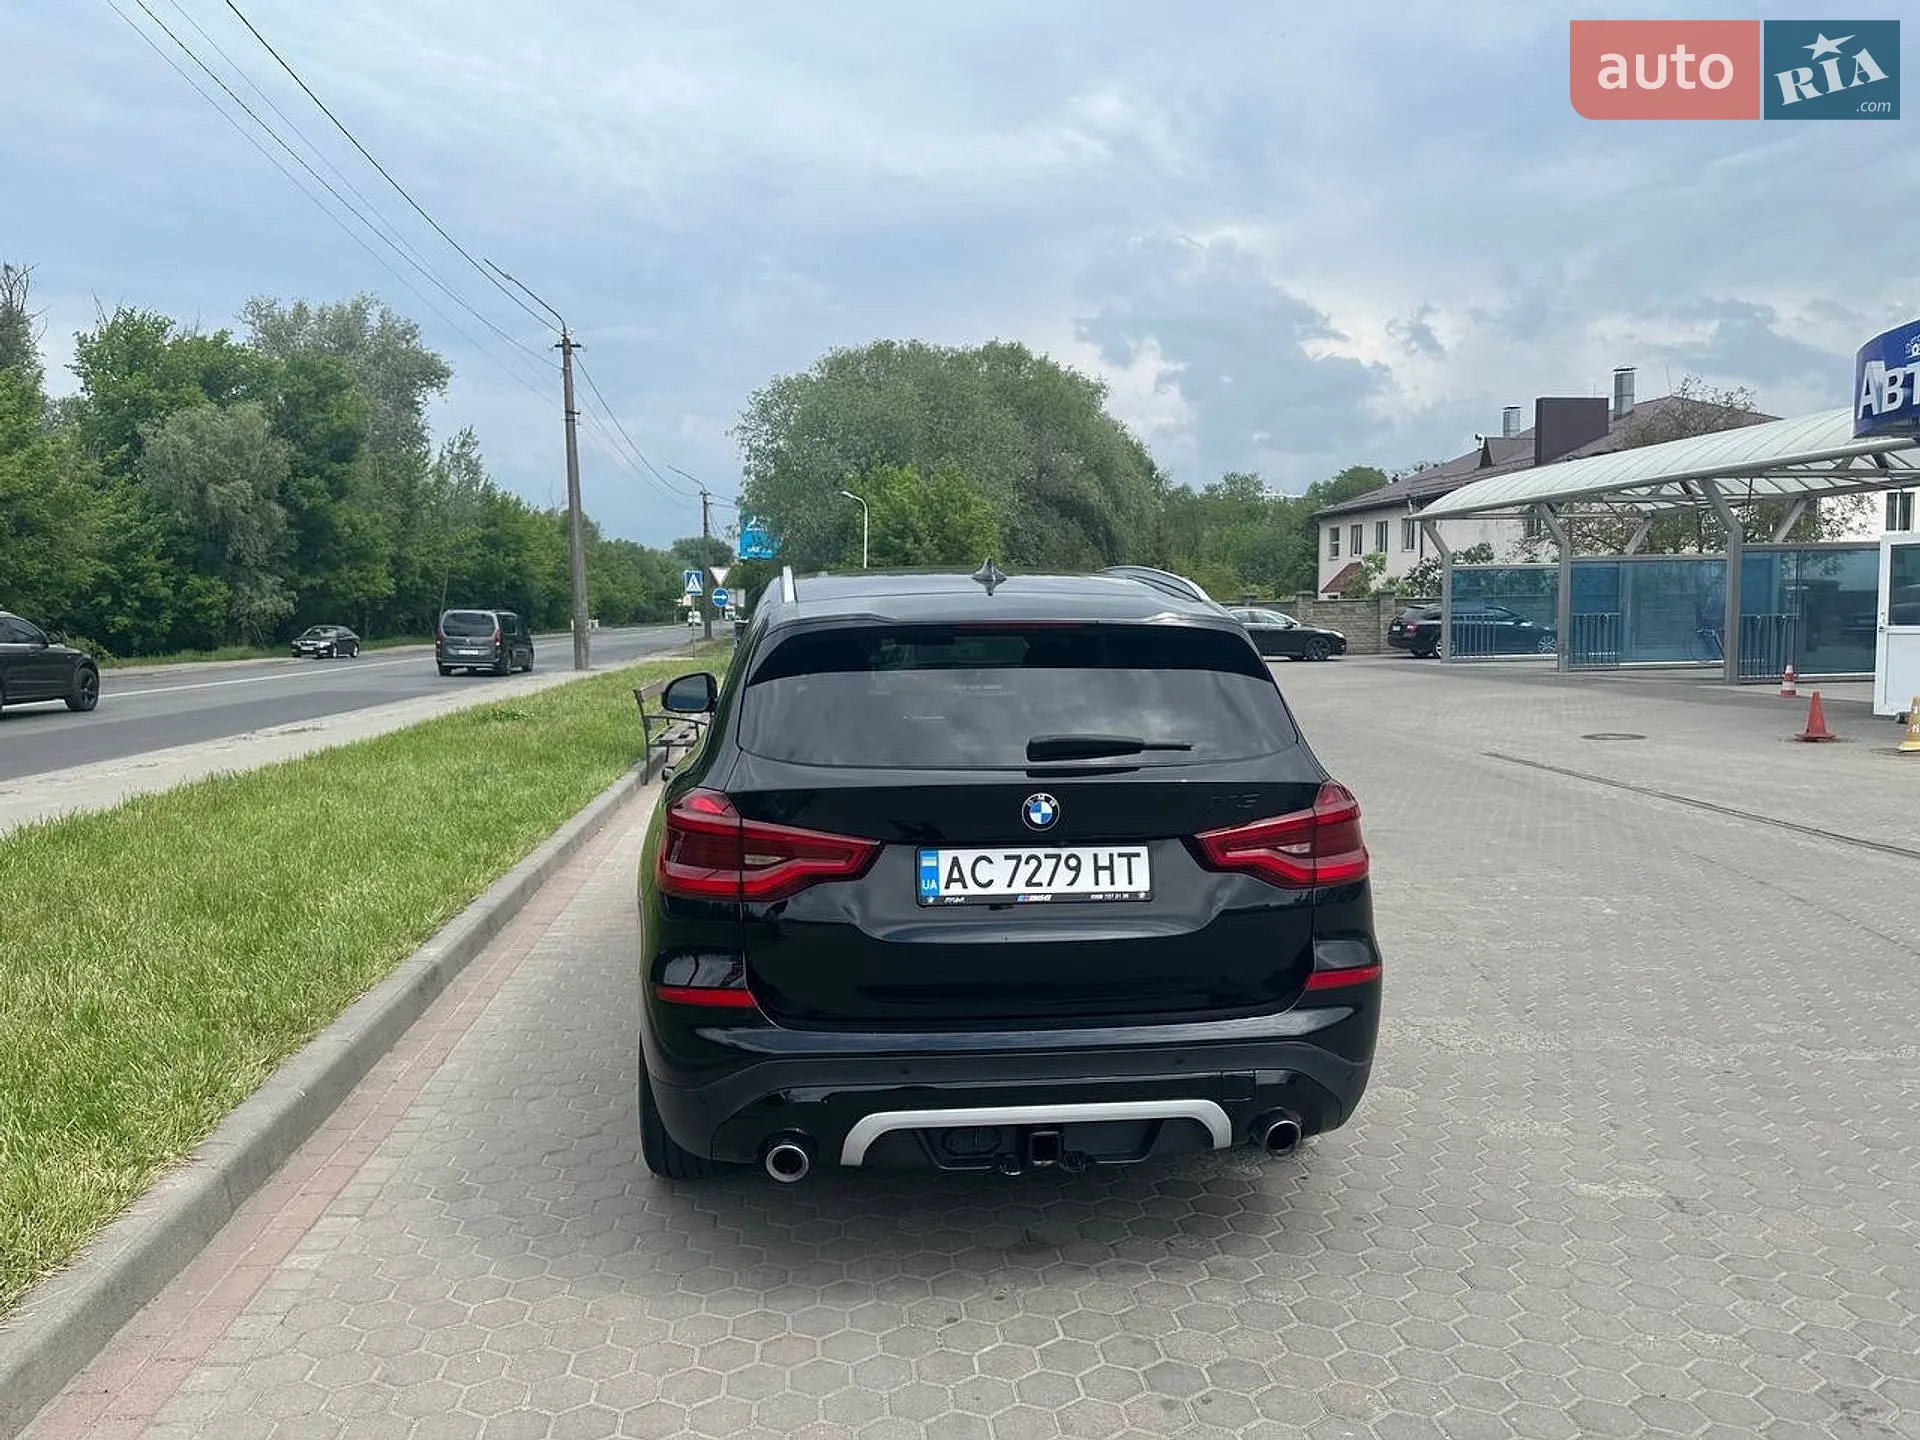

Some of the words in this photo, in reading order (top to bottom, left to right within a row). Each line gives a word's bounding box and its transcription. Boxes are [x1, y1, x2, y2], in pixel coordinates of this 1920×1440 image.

[944, 854, 994, 890] AC
[1003, 852, 1082, 888] 7279
[1093, 851, 1141, 886] HT
[921, 878, 938, 890] UA
